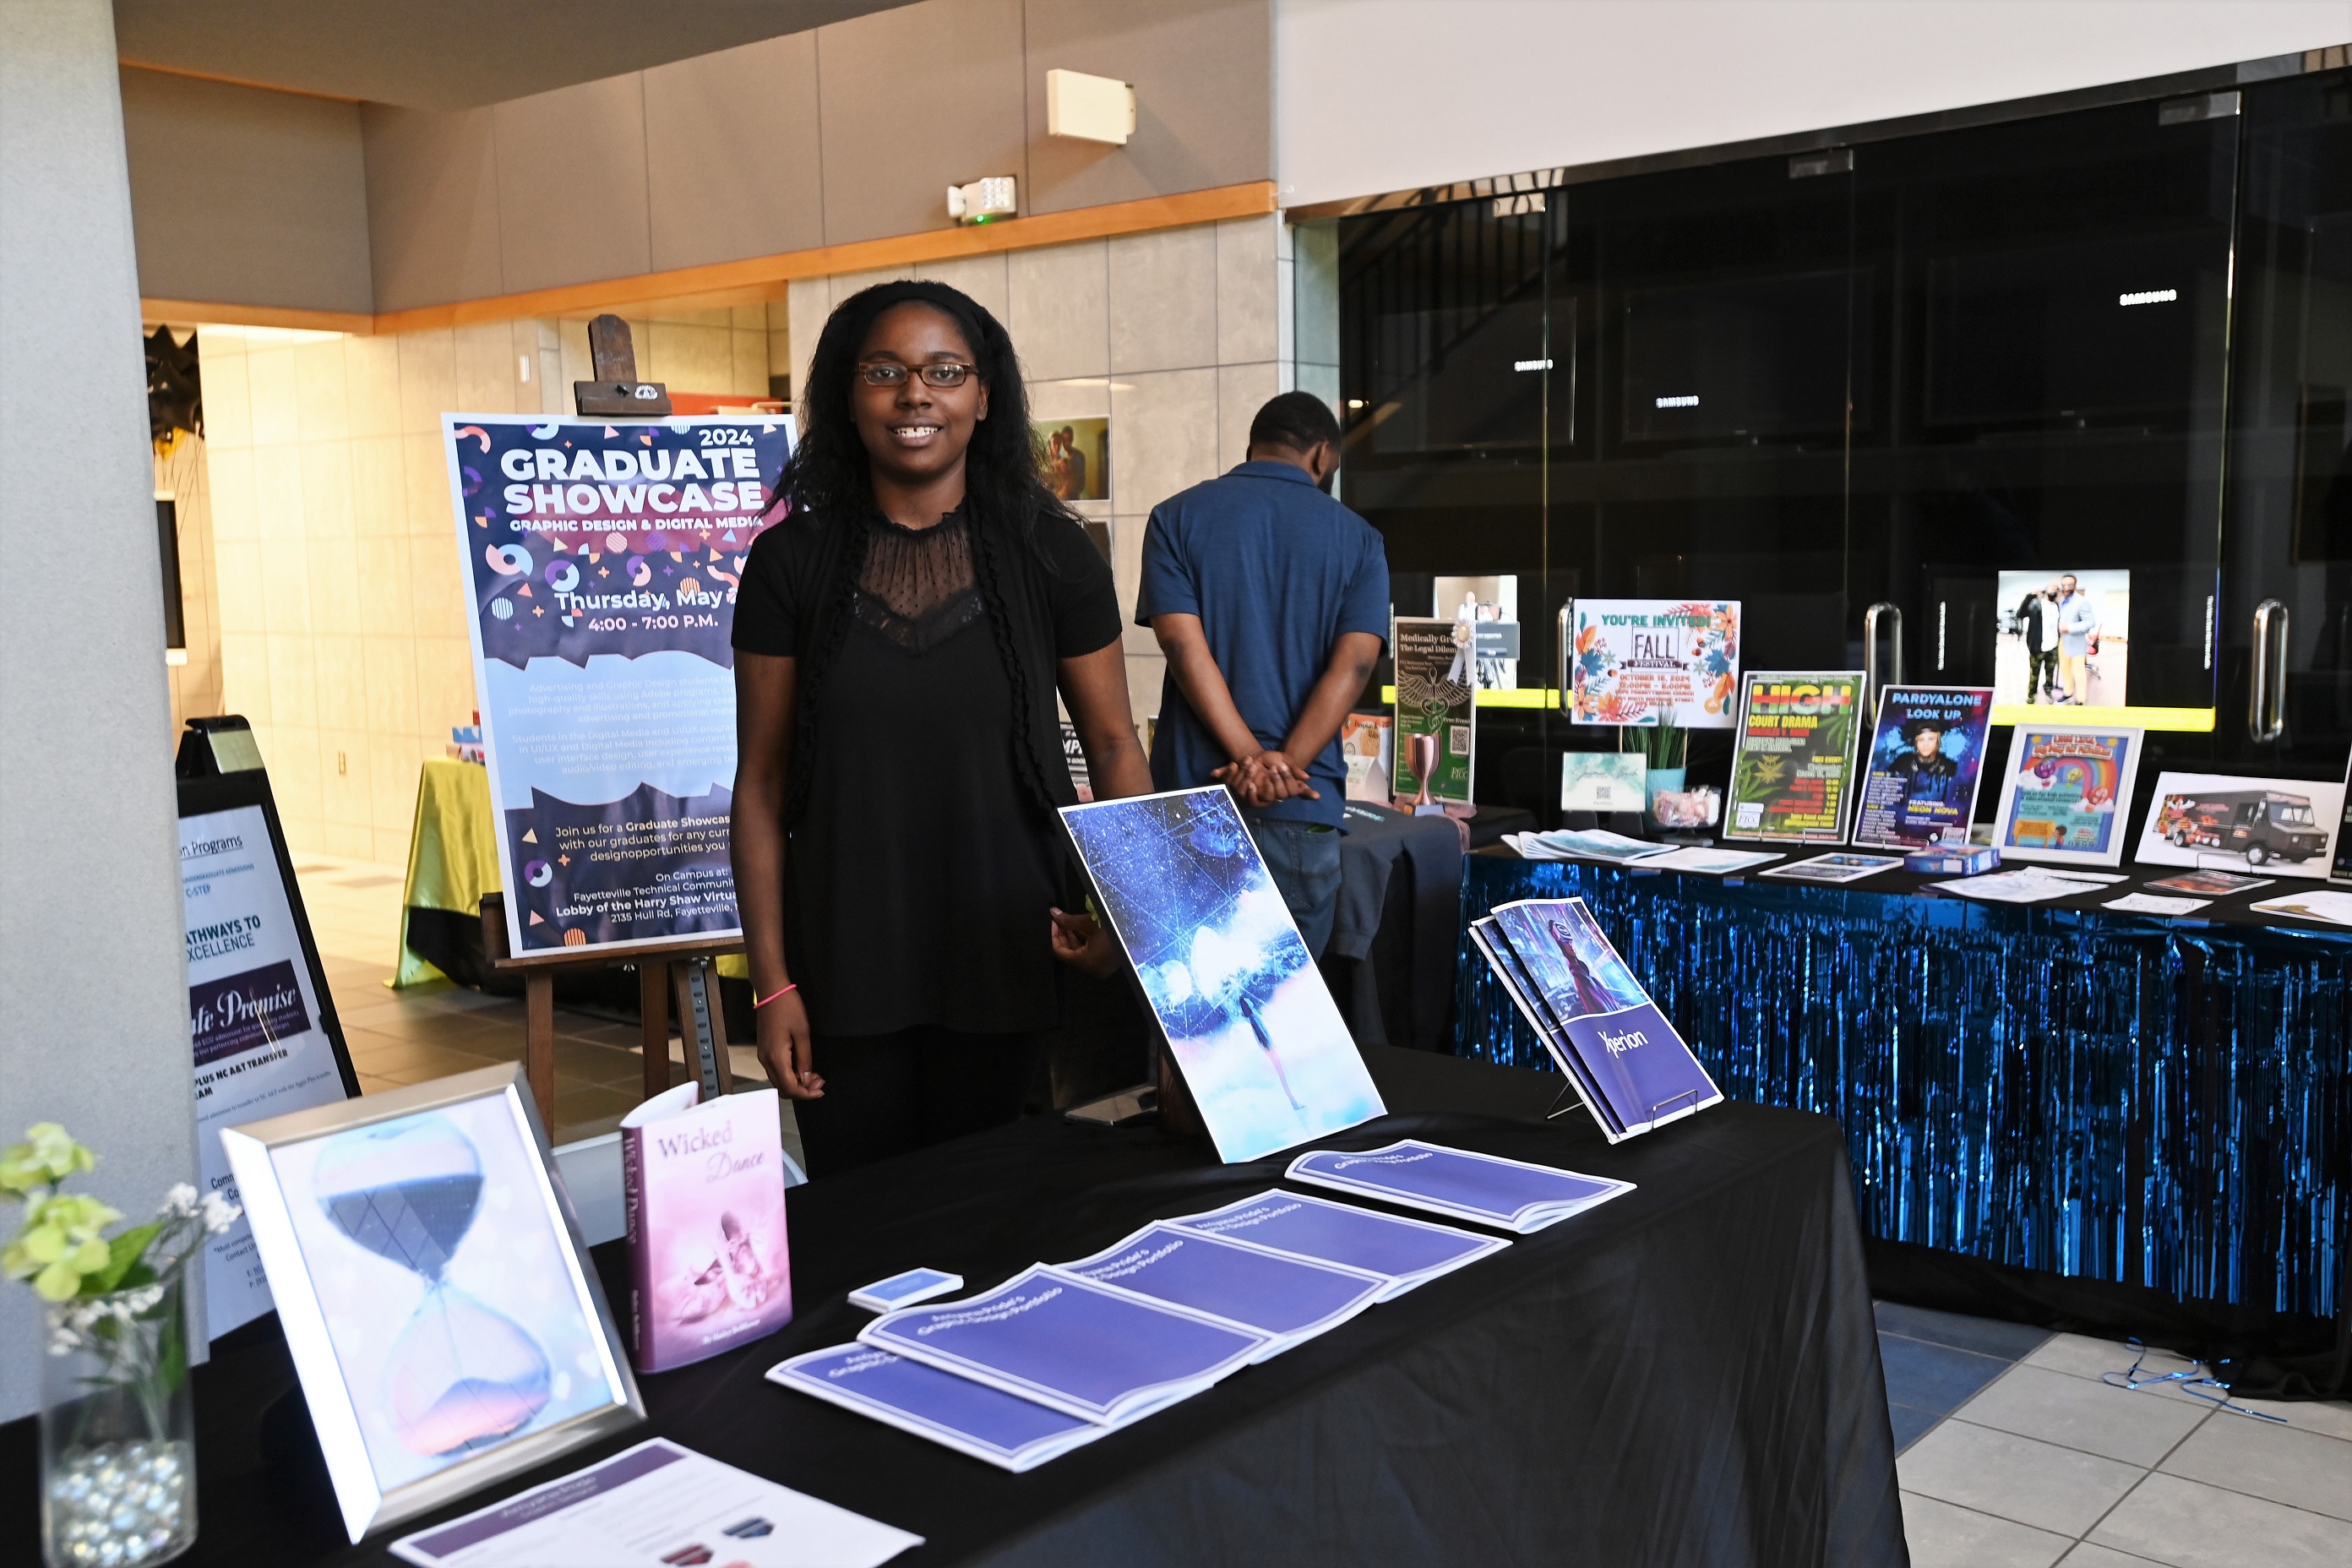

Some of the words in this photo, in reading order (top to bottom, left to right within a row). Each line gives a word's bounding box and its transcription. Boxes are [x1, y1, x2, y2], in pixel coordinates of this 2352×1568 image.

[2120, 289, 2177, 306] SAMSUNG
[1656, 395, 1700, 409] SAMSUNG
[699, 428, 754, 446] 2024
[500, 448, 760, 482] GRADUATE
[504, 482, 765, 514] SHOWCASE
[509, 519, 579, 532] GRAPHIC
[582, 519, 638, 532] DESIGN
[641, 518, 651, 531] &
[655, 517, 713, 531] DIGITAL
[716, 514, 764, 529] MEDIA
[554, 590, 671, 612] Thursday,
[676, 590, 723, 610] May
[588, 617, 627, 632] 4:00
[641, 615, 678, 630] 7:00
[683, 613, 719, 629] P.M.
[1601, 614, 1649, 627] YOU'RE
[1652, 615, 1712, 628] INVITED!
[1399, 633, 1439, 645] Medically
[1635, 634, 1675, 660] FALL
[1413, 644, 1435, 654] Legal
[1635, 660, 1676, 668] FESTIVAL
[530, 682, 584, 693] Advertising
[586, 682, 604, 690] and
[607, 678, 642, 691] Graphic
[645, 678, 676, 689] Design
[679, 677, 718, 686] students
[589, 692, 611, 700] skills
[613, 692, 640, 701] using
[642, 689, 671, 698] Adobe
[1751, 684, 1852, 714] HIGH
[1892, 692, 1983, 706] PARDYALONE
[509, 704, 570, 717] photography
[652, 700, 669, 709] and
[672, 698, 710, 709] applying
[579, 712, 629, 723] advertising
[633, 711, 650, 720] and
[653, 708, 708, 719] promotional
[1906, 708, 1940, 721] LOOK
[1944, 710, 1962, 721] UP
[1749, 715, 1780, 727] COURT
[1782, 716, 1818, 728] DRAMA
[513, 734, 557, 743] Students
[558, 732, 568, 741] in
[569, 732, 586, 740] the
[588, 730, 619, 741] Digital
[621, 728, 650, 738] Media
[672, 725, 698, 734] UI/UX
[519, 745, 528, 754] in
[531, 744, 558, 754] UI/UX
[561, 743, 579, 752] and
[581, 741, 612, 752] Digital
[615, 740, 643, 749] Media
[645, 737, 689, 748] including
[691, 734, 726, 743] content
[535, 756, 555, 765] user
[558, 754, 599, 764] interface
[602, 751, 636, 761] design,
[660, 747, 710, 757] experience
[562, 764, 617, 774] audio/video
[677, 756, 721, 766] emerging
[1908, 805, 1932, 814] NEON
[1934, 806, 1959, 815] NOVA
[556, 826, 580, 838] Join
[583, 825, 596, 835] us
[598, 823, 614, 834] for
[617, 825, 623, 833] a
[625, 818, 678, 832] Graduate
[681, 815, 730, 828] Showcas
[192, 835, 243, 855] Programs
[559, 839, 585, 851] with
[588, 838, 607, 848] our
[610, 834, 667, 849] graduates
[668, 830, 684, 841] for
[686, 830, 705, 842] any
[709, 829, 730, 838] curr
[591, 841, 704, 861] designopportunities
[705, 841, 726, 852] you
[656, 872, 671, 883] On
[673, 869, 714, 882] Campus
[716, 868, 728, 877] at:
[186, 883, 211, 898] C-STEP
[574, 888, 631, 902] Fayetteville
[633, 884, 681, 896] Technical
[556, 904, 594, 918] Lobby
[596, 901, 610, 913] of
[612, 900, 631, 912] the
[634, 896, 667, 910] Harry
[669, 893, 701, 906] Shaw
[611, 912, 633, 923] 2135
[634, 910, 654, 921] Hull
[656, 908, 673, 919] Rd,
[676, 903, 733, 917] Fayetteville,
[186, 918, 243, 945] ATHWAYS
[243, 913, 261, 931] TO
[188, 933, 255, 963] XCELLENCE
[216, 983, 296, 1028] Promise
[1598, 1028, 1648, 1059] Xperion
[215, 1068, 230, 1081] NC
[229, 1061, 248, 1075] A&T
[247, 1048, 289, 1070] TRANSFER
[657, 1119, 732, 1159] Wicked
[705, 1149, 764, 1184] Dance
